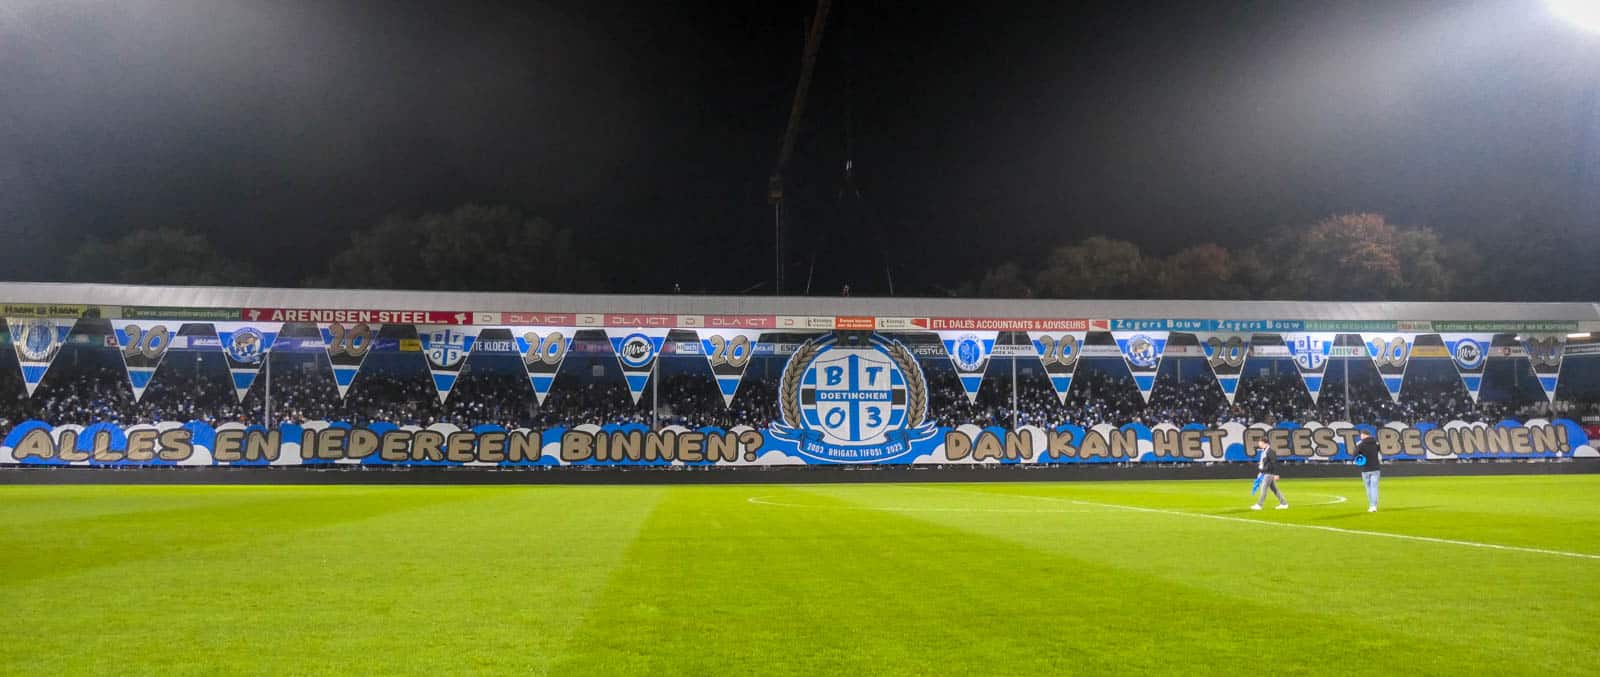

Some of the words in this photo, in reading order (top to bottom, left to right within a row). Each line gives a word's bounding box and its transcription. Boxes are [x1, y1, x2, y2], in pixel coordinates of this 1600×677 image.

[271, 309, 436, 323] ARENDSEN-STEEL
[544, 316, 568, 324] ICT
[646, 317, 669, 325] ICT
[745, 318, 768, 326] ICT
[933, 320, 947, 329] ETL
[949, 320, 975, 329] DALES
[976, 320, 1033, 329] ACCOUNTANTS
[1035, 320, 1041, 329] &
[1042, 320, 1086, 329] ADVISEURS
[1116, 319, 1162, 330] Zegers
[1166, 319, 1201, 329] Bouw
[1217, 320, 1261, 331] Zegers
[1266, 320, 1301, 329] Bouw
[124, 324, 169, 359] 20
[328, 322, 371, 357] 20
[523, 331, 566, 365] 20
[1040, 334, 1078, 366] 20
[710, 334, 751, 368] 20
[1207, 336, 1244, 367] 20
[1372, 337, 1408, 367] 20
[820, 392, 888, 401] DOETINCHEM
[11, 428, 194, 461] ALLES
[213, 429, 282, 461] EN
[300, 428, 543, 462] IEDEREEN
[560, 430, 764, 462] BINNEN?
[828, 447, 858, 457] BRIGATA
[860, 448, 882, 457] TIFOSI
[944, 428, 1033, 460] DAN
[1047, 428, 1138, 459] KAN
[1152, 428, 1228, 459] HET
[1243, 427, 1362, 459] FEEST
[1377, 424, 1571, 457] BEGINNEN!
